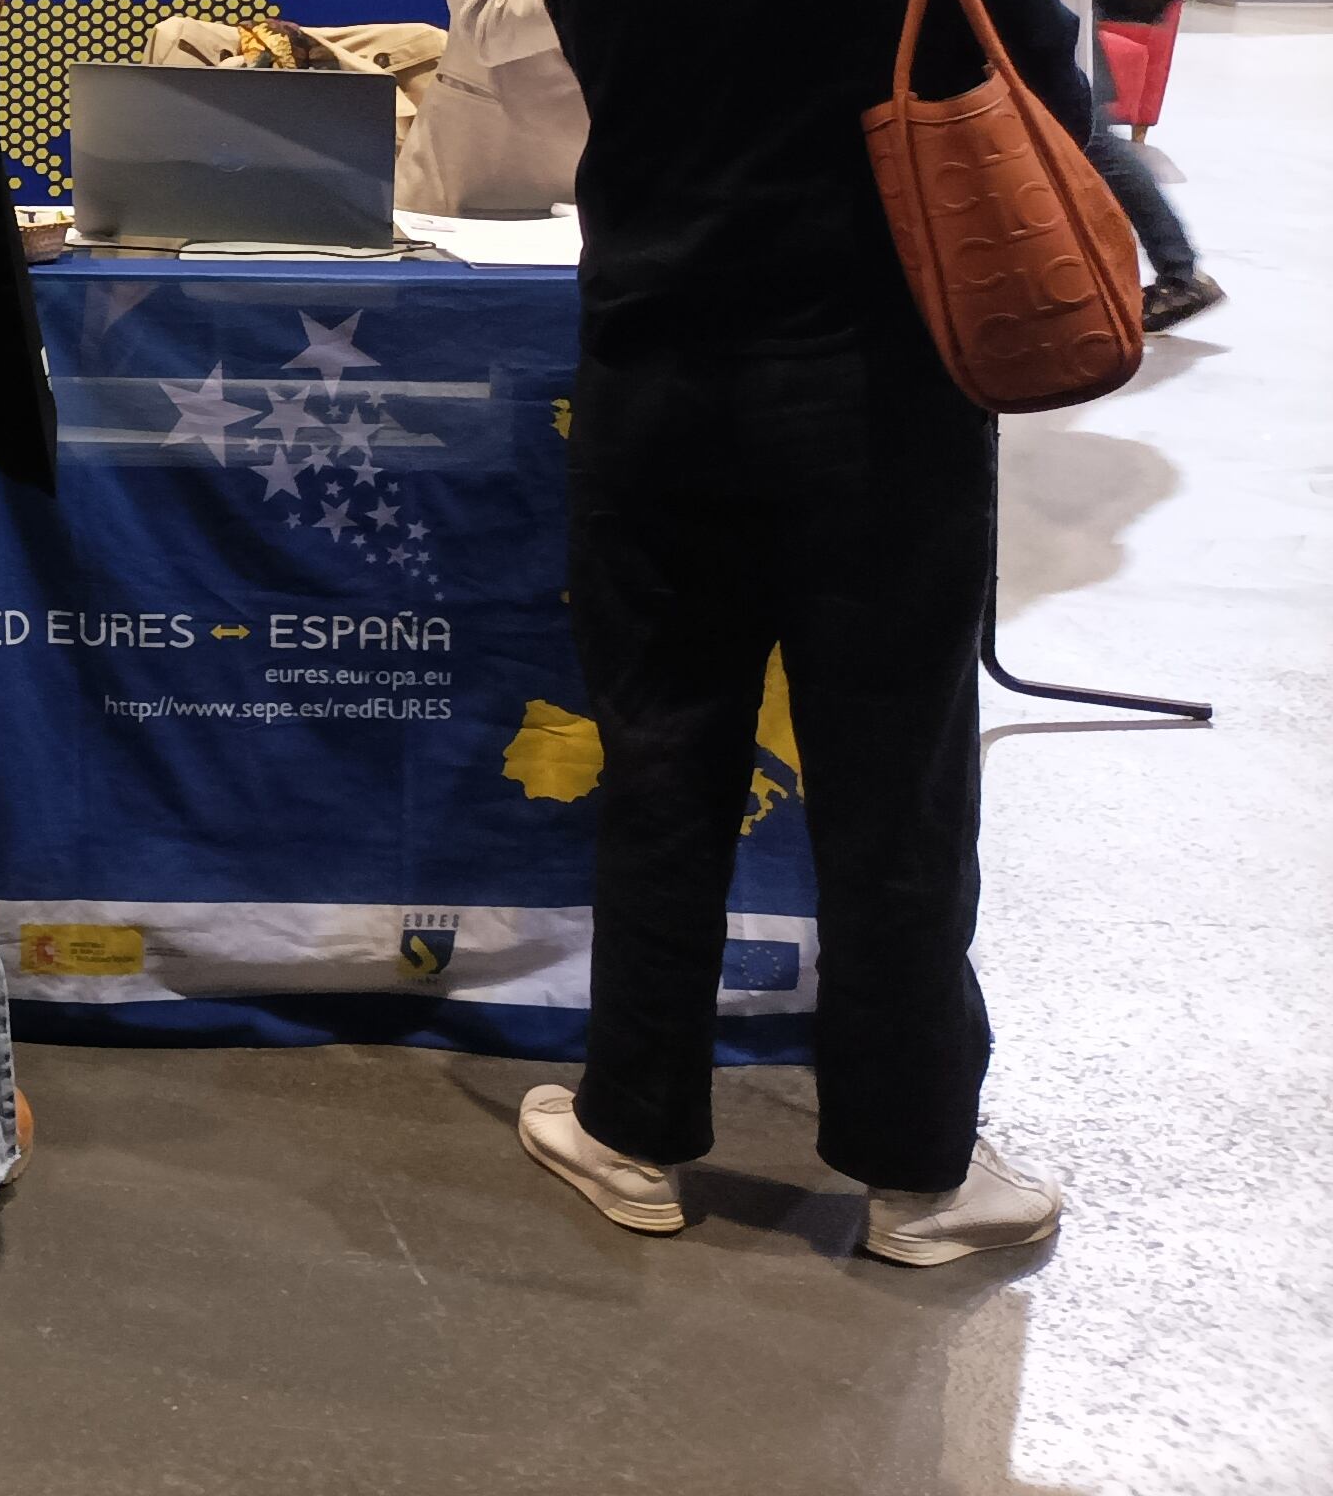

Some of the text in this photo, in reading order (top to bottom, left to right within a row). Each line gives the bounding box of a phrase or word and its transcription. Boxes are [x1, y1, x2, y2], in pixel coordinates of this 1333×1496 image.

[48, 610, 195, 648] EURES
[270, 610, 451, 651] ESPAÑA
[265, 666, 451, 688] eures.europa.eu
[105, 694, 451, 721] http://www.sepe.es/redEURES
[404, 913, 459, 927] EURES
